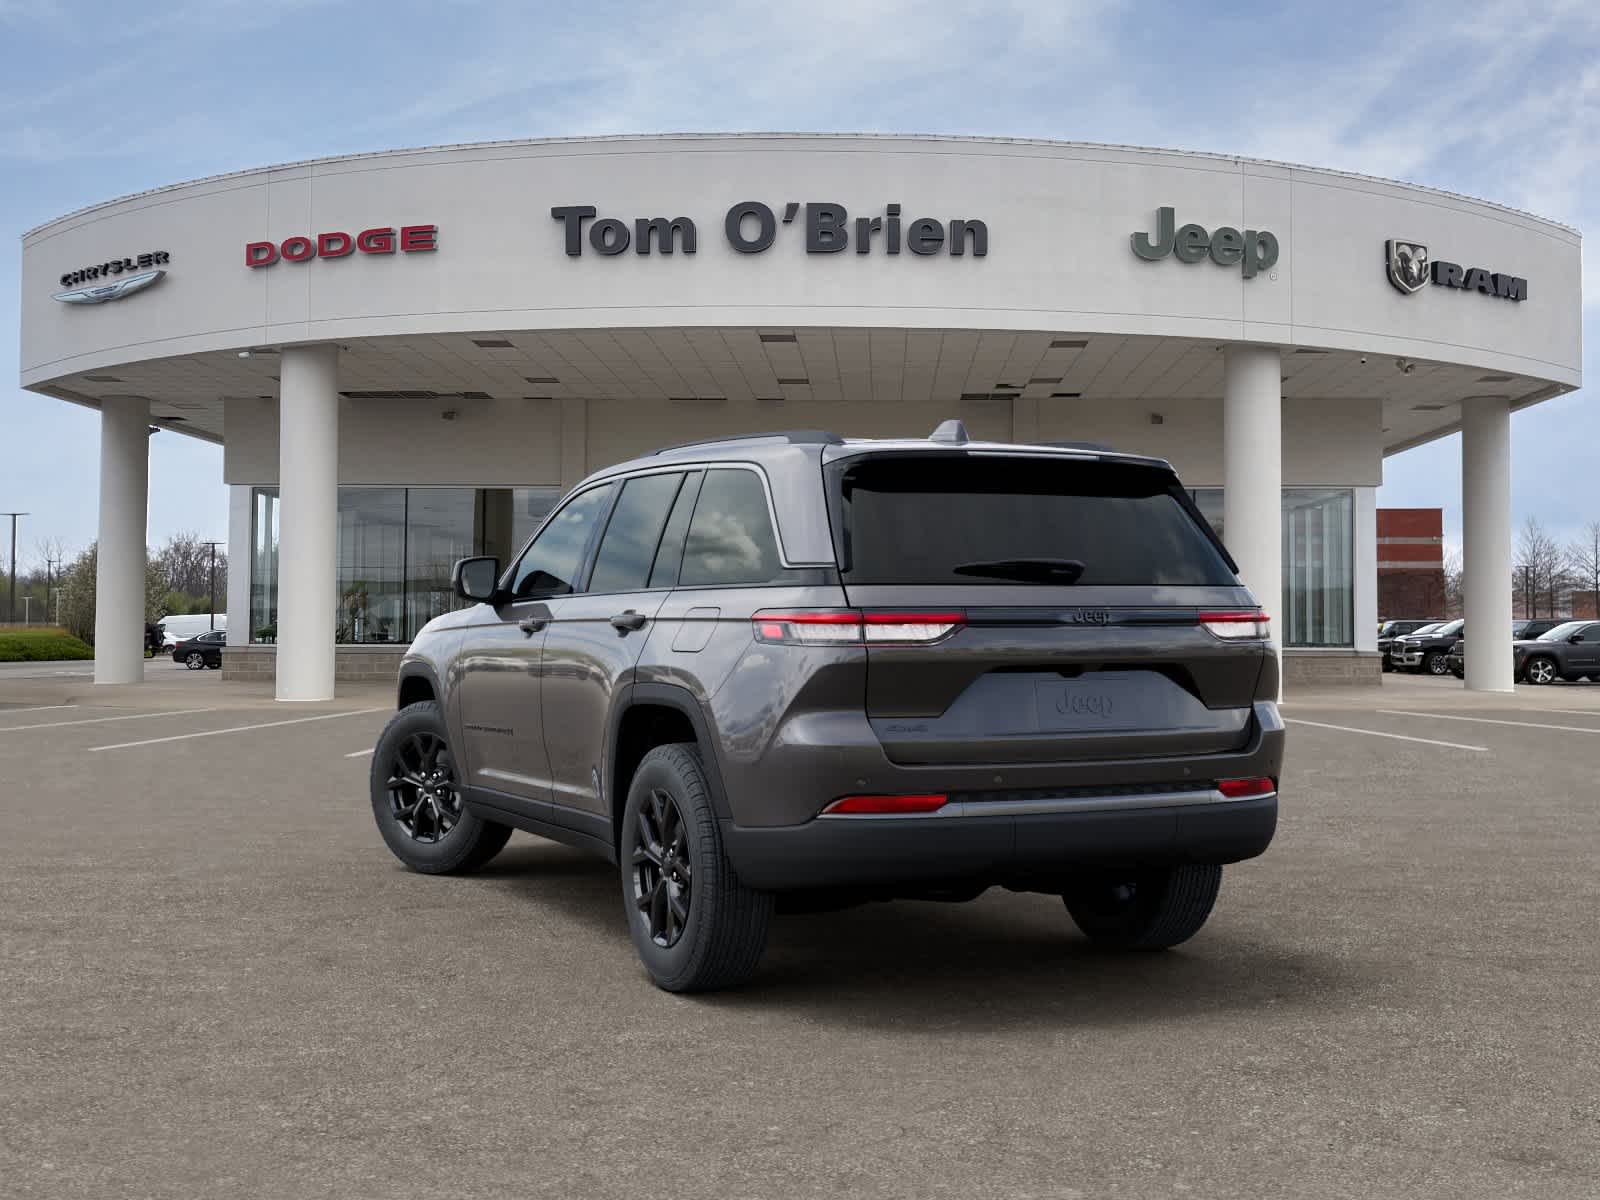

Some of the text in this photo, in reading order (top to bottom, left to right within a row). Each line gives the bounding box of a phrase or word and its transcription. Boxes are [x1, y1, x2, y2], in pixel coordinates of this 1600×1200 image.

[244, 224, 438, 269] DODGE
[551, 201, 988, 256] Tom O'Brien
[1130, 206, 1279, 279] Jeep
[60, 250, 170, 287] CHRYSLER
[1430, 260, 1527, 301] RAM
[1072, 607, 1112, 625] Jeep
[1055, 687, 1113, 719] Jeep
